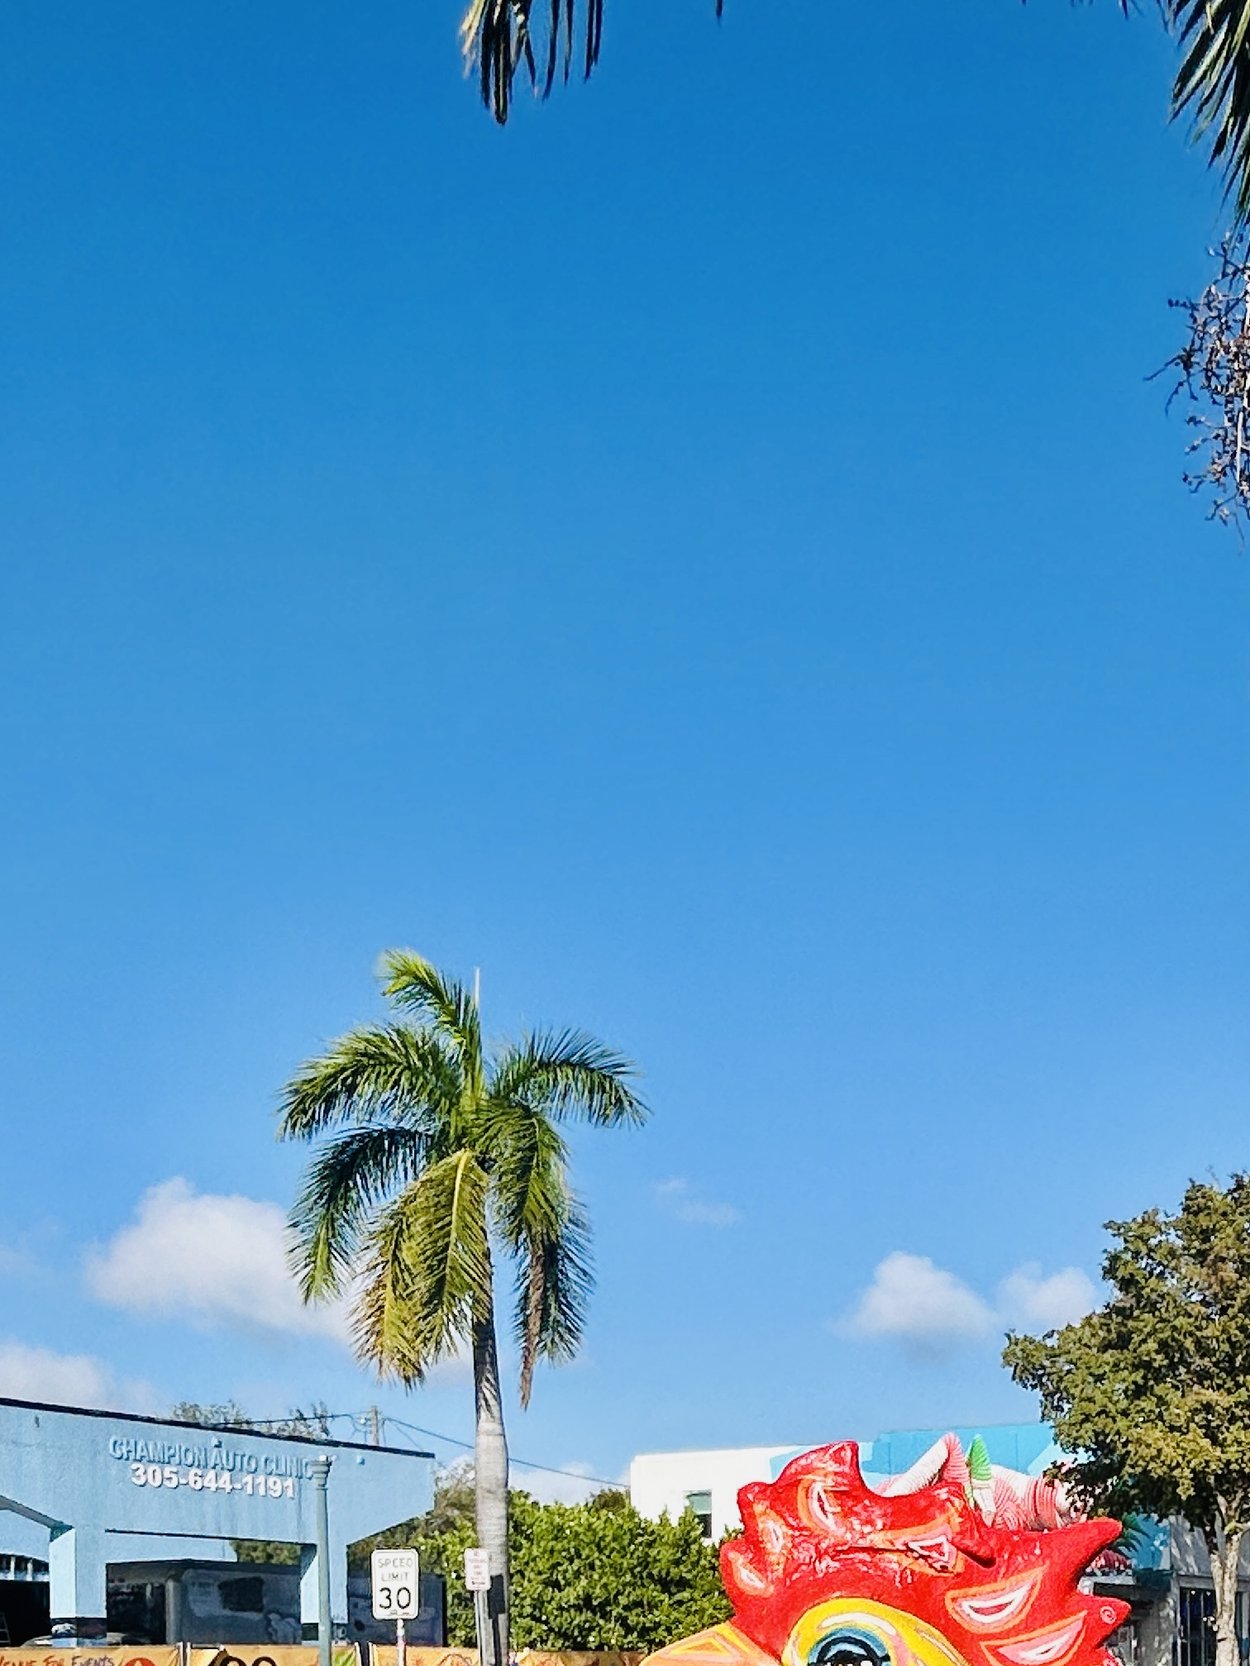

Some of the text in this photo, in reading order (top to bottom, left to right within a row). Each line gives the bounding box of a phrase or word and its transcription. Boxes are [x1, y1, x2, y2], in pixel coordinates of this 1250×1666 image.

[109, 1436, 314, 1480] CHAMPION AUTO CLINIC
[130, 1462, 296, 1499] 305-644-1191
[378, 1557, 413, 1569] SPEED
[381, 1571, 409, 1582] LIMIT
[379, 1586, 411, 1609] 30
